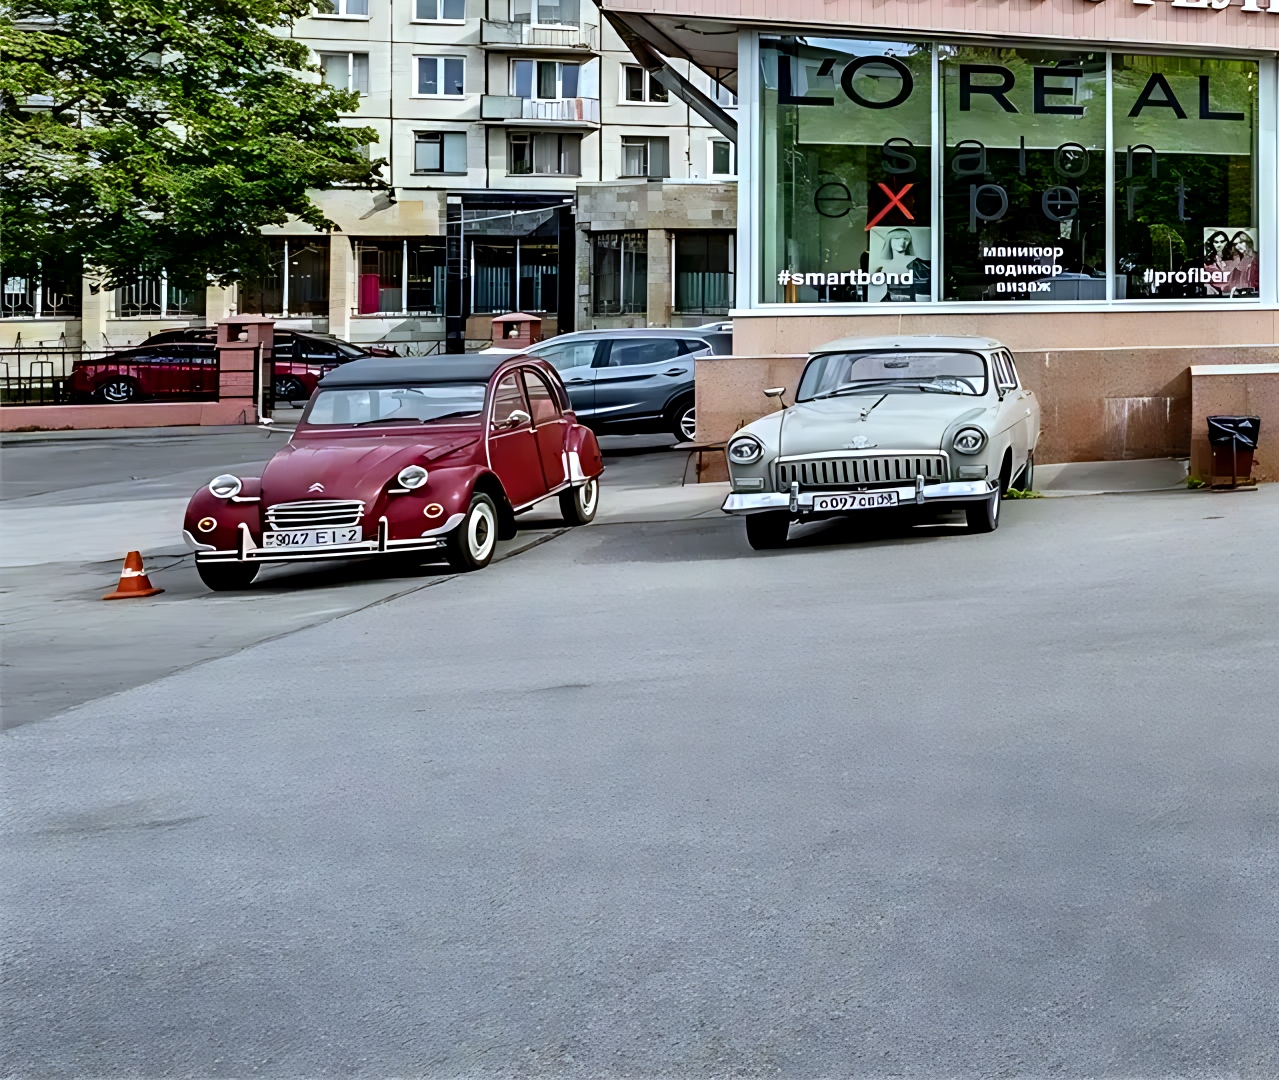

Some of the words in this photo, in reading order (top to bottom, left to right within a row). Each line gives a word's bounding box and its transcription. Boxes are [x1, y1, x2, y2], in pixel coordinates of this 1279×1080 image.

[881, 135, 1158, 179] salon
[813, 177, 1193, 233] expert
[777, 268, 915, 287] #smartbond
